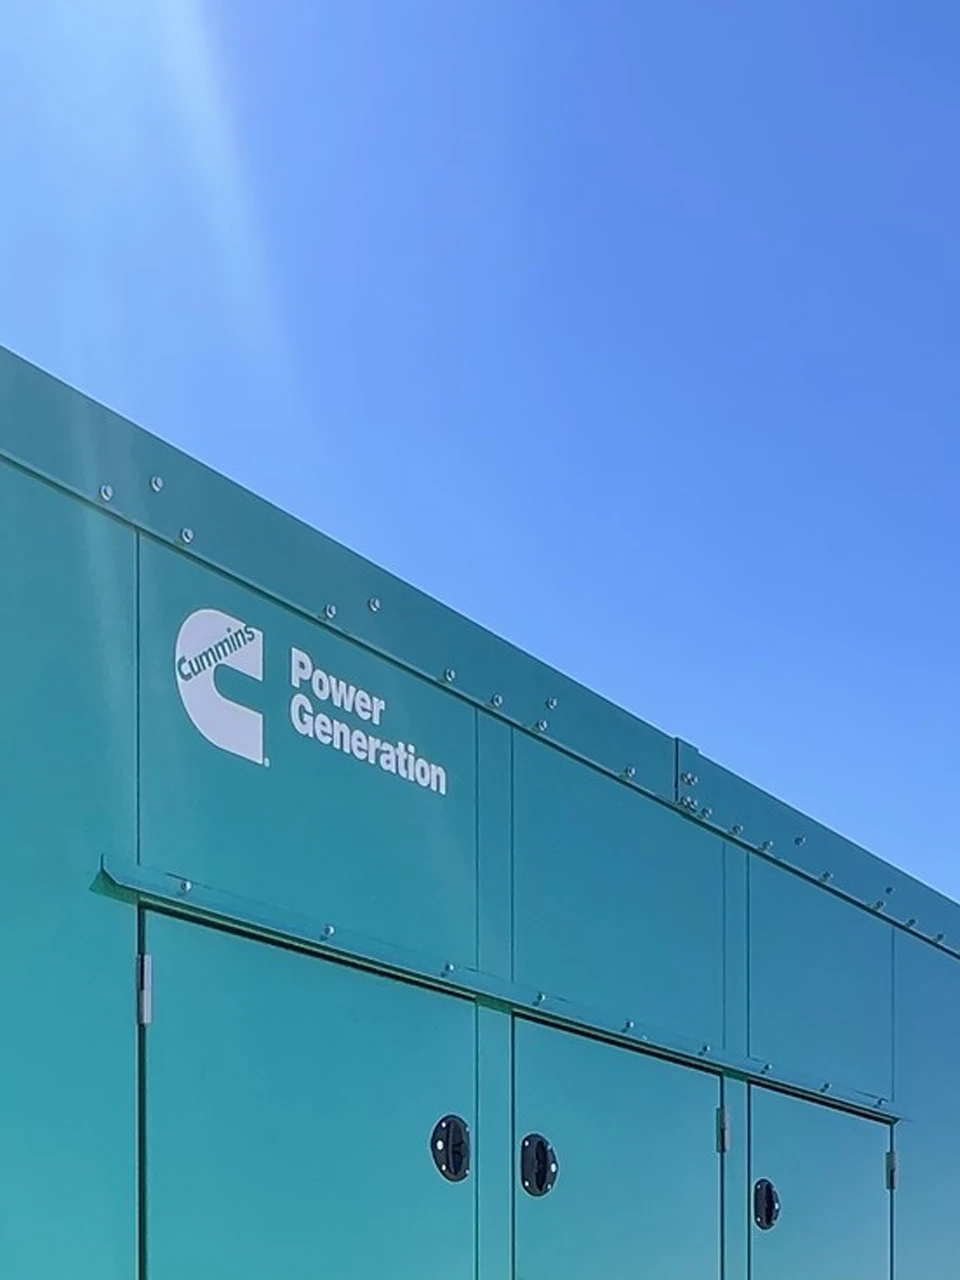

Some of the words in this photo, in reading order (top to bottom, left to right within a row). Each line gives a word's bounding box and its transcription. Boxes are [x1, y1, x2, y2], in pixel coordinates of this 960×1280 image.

[177, 625, 255, 682] Cummins
[291, 646, 385, 726] Power
[290, 693, 447, 796] Generation
